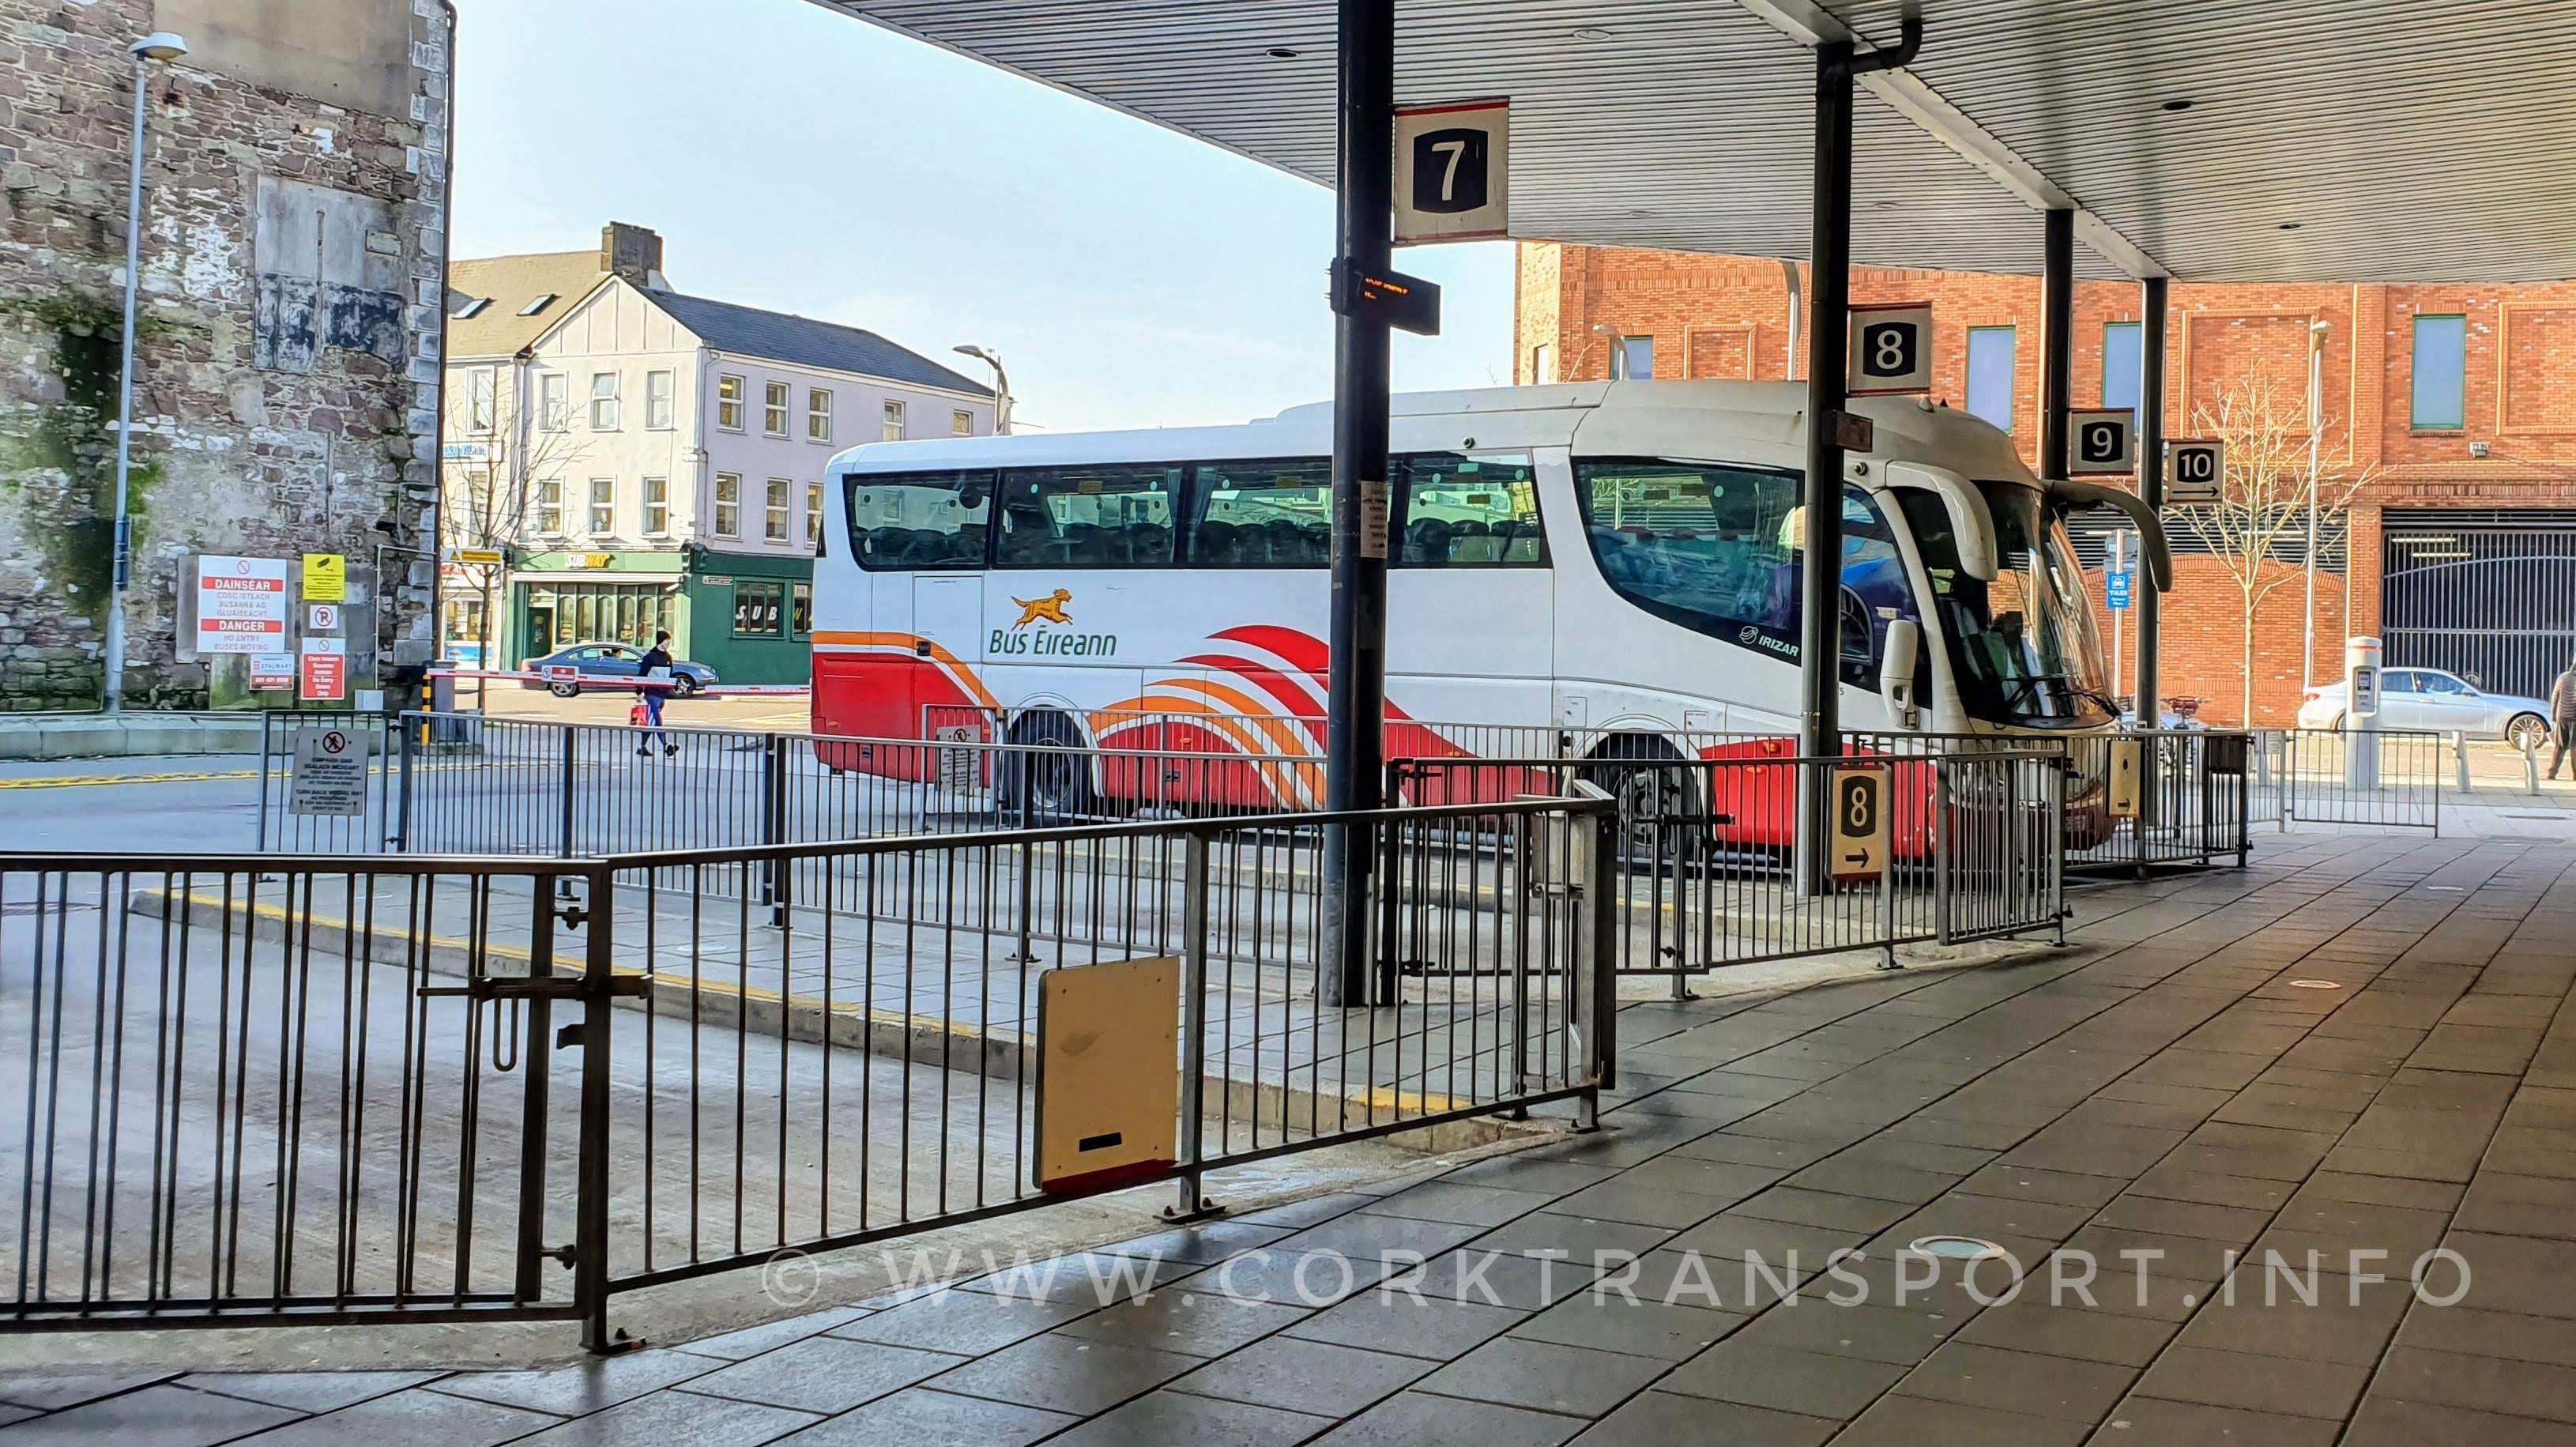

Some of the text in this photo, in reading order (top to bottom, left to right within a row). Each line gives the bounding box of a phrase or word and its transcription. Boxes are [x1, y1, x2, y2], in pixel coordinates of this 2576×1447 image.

[1431, 140, 1465, 202] 7
[1875, 330, 1904, 370] 8
[2092, 428, 2113, 458] 9
[2180, 454, 2212, 478] 10
[568, 554, 610, 568] SUBWAY
[214, 578, 271, 591] DAINSEAR
[218, 620, 266, 631] DANGER
[989, 624, 1117, 657] Bus Éireann
[1758, 634, 1800, 658] IRIZAR
[1849, 786, 1868, 827] 8
